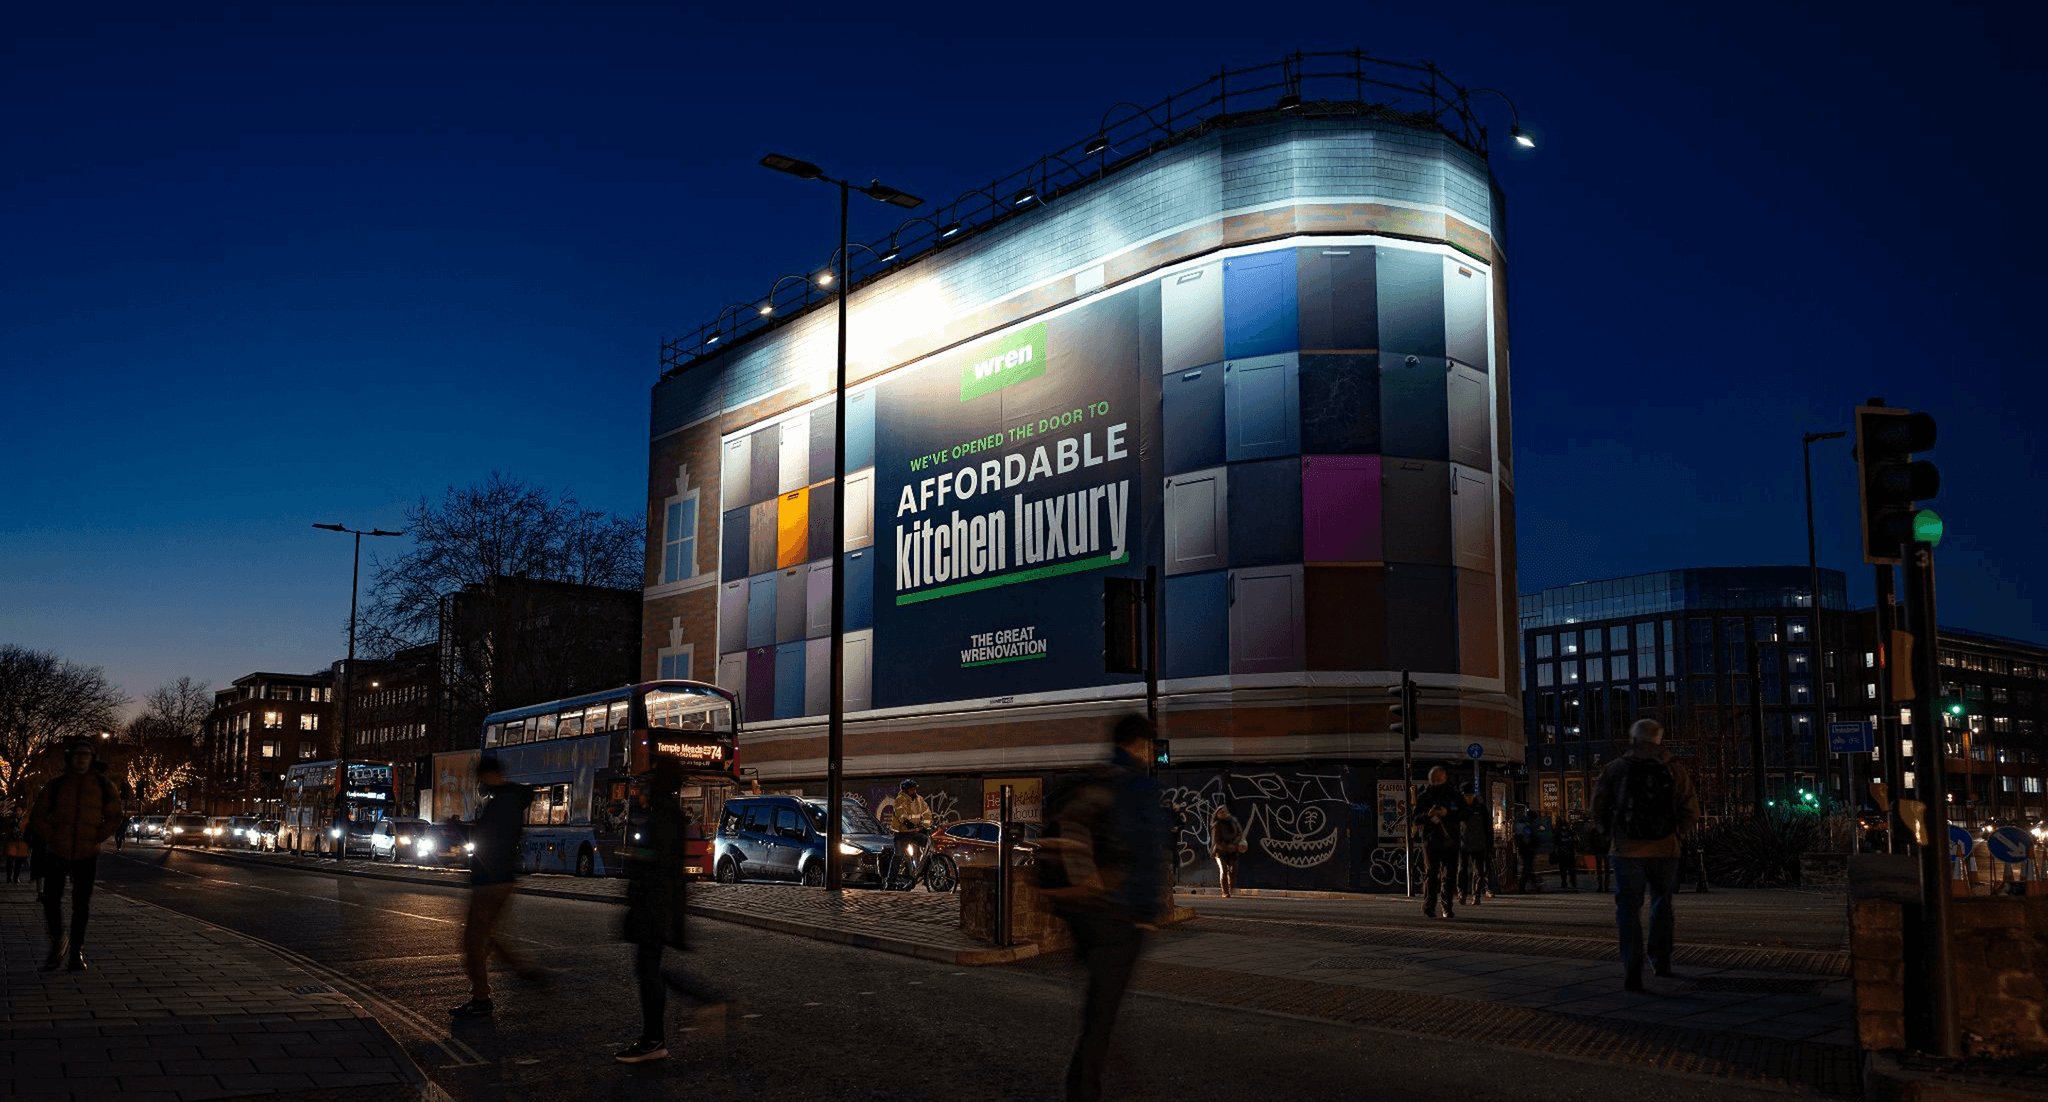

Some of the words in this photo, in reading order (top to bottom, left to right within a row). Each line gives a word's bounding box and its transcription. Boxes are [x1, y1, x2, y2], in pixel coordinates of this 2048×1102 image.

[974, 344, 1033, 380] wren
[909, 449, 949, 472] WE'VE
[951, 432, 1004, 460] OPENED
[1008, 423, 1034, 443] THE
[1038, 408, 1083, 433] DOOR
[1088, 401, 1109, 418] TO
[896, 422, 1128, 518] AFFORDABLE
[896, 507, 1006, 591] kitchen
[1014, 479, 1130, 566] luxury
[1914, 549, 1929, 567] 3
[960, 638, 1047, 663] WRENOVATION
[970, 633, 994, 648] THE
[995, 626, 1036, 643] GREAT
[658, 743, 681, 754] Temple
[681, 743, 704, 754] Meads
[711, 745, 722, 760] 74
